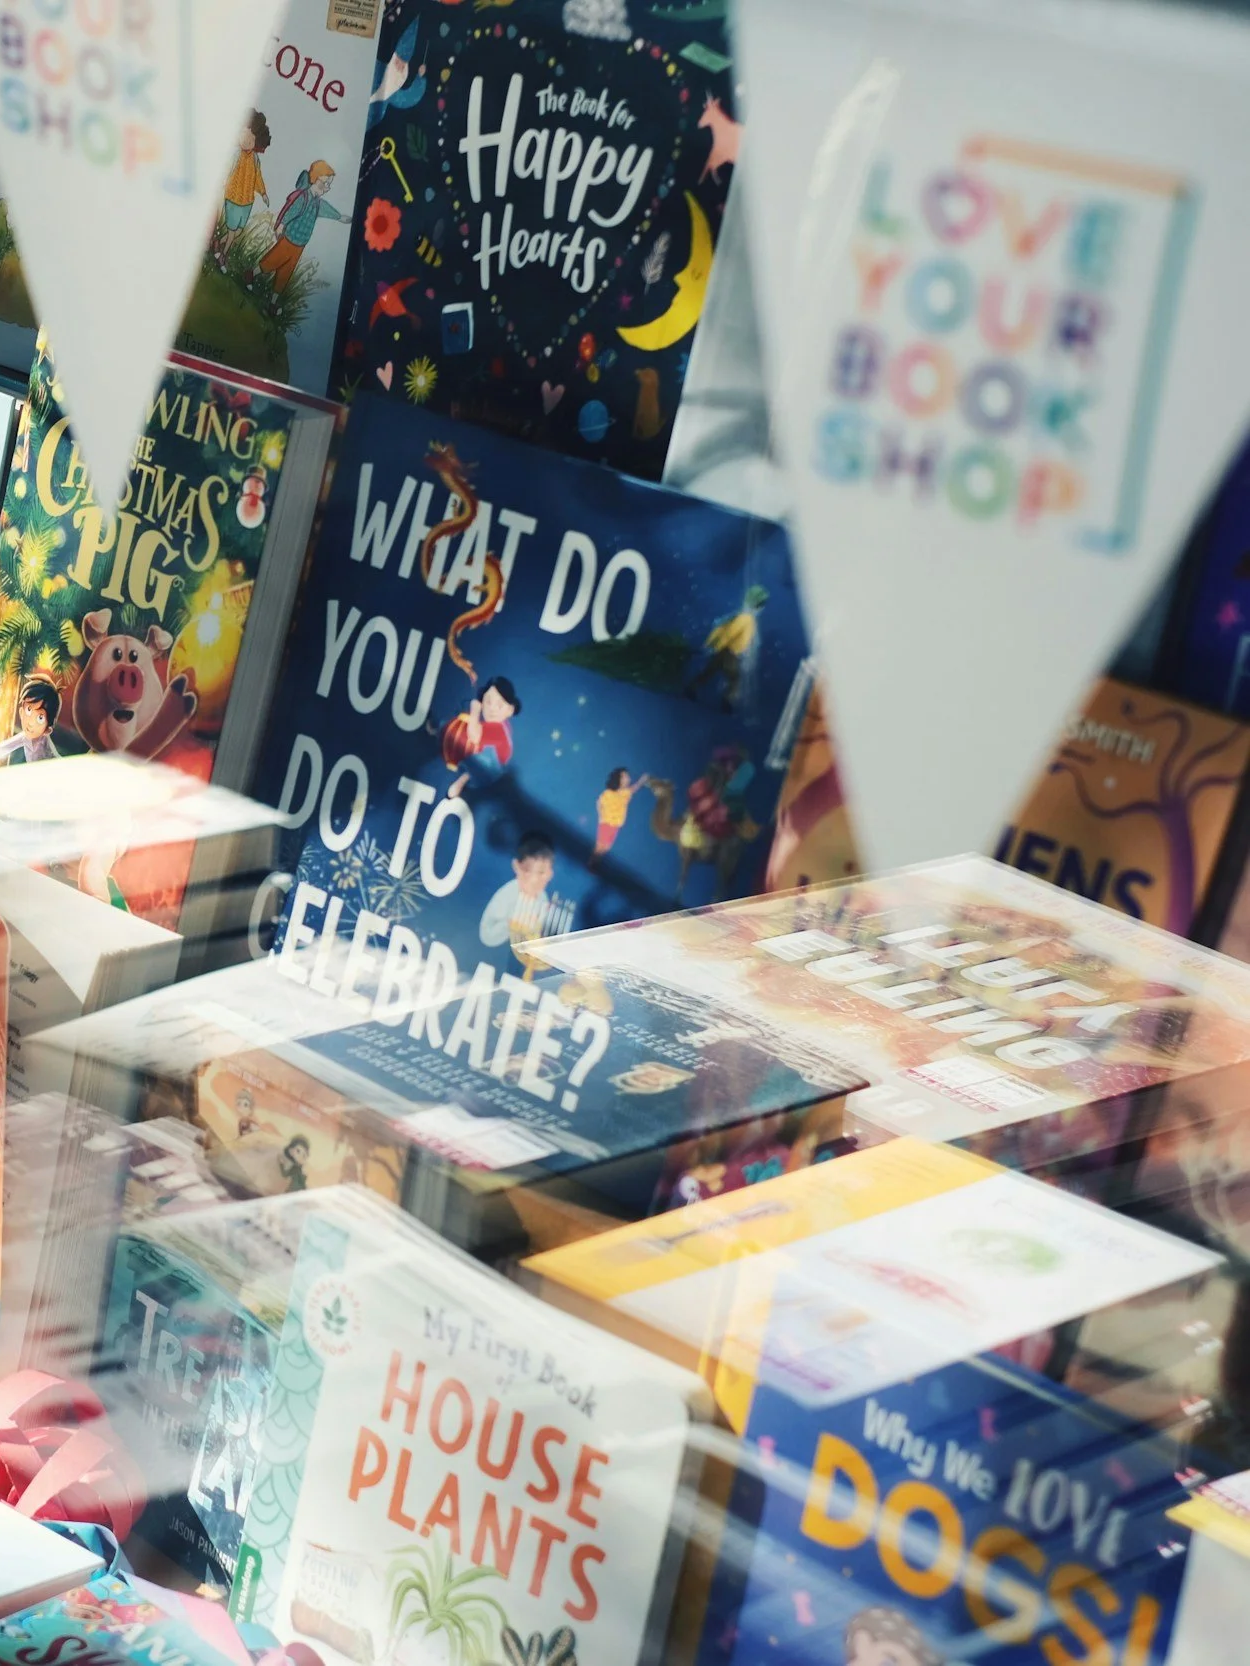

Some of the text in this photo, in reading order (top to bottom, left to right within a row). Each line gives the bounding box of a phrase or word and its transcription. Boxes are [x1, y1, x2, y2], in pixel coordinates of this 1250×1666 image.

[268, 37, 347, 114] one
[536, 83, 638, 131] The Book for
[458, 72, 654, 228] Happy
[472, 203, 607, 294] Hearts
[859, 163, 1123, 284] LOVE
[855, 246, 1112, 364] YOUR
[147, 387, 258, 461] WLING
[829, 325, 1088, 453] BOOK
[813, 405, 1085, 531] SHOP
[68, 505, 184, 623] PIG
[350, 462, 651, 643] WHAT DO
[316, 598, 448, 733] YOU
[1065, 714, 1158, 765] SMITH
[278, 733, 476, 898] DO TO
[248, 871, 611, 1112] CELEBRATE?
[424, 1305, 598, 1420] My First Book
[380, 1349, 610, 1530] HOUSE
[863, 1398, 938, 1480] Why
[943, 1438, 998, 1501] We
[169, 1516, 238, 1575] JASON PAMMENT
[348, 1425, 606, 1622] PLANTS
